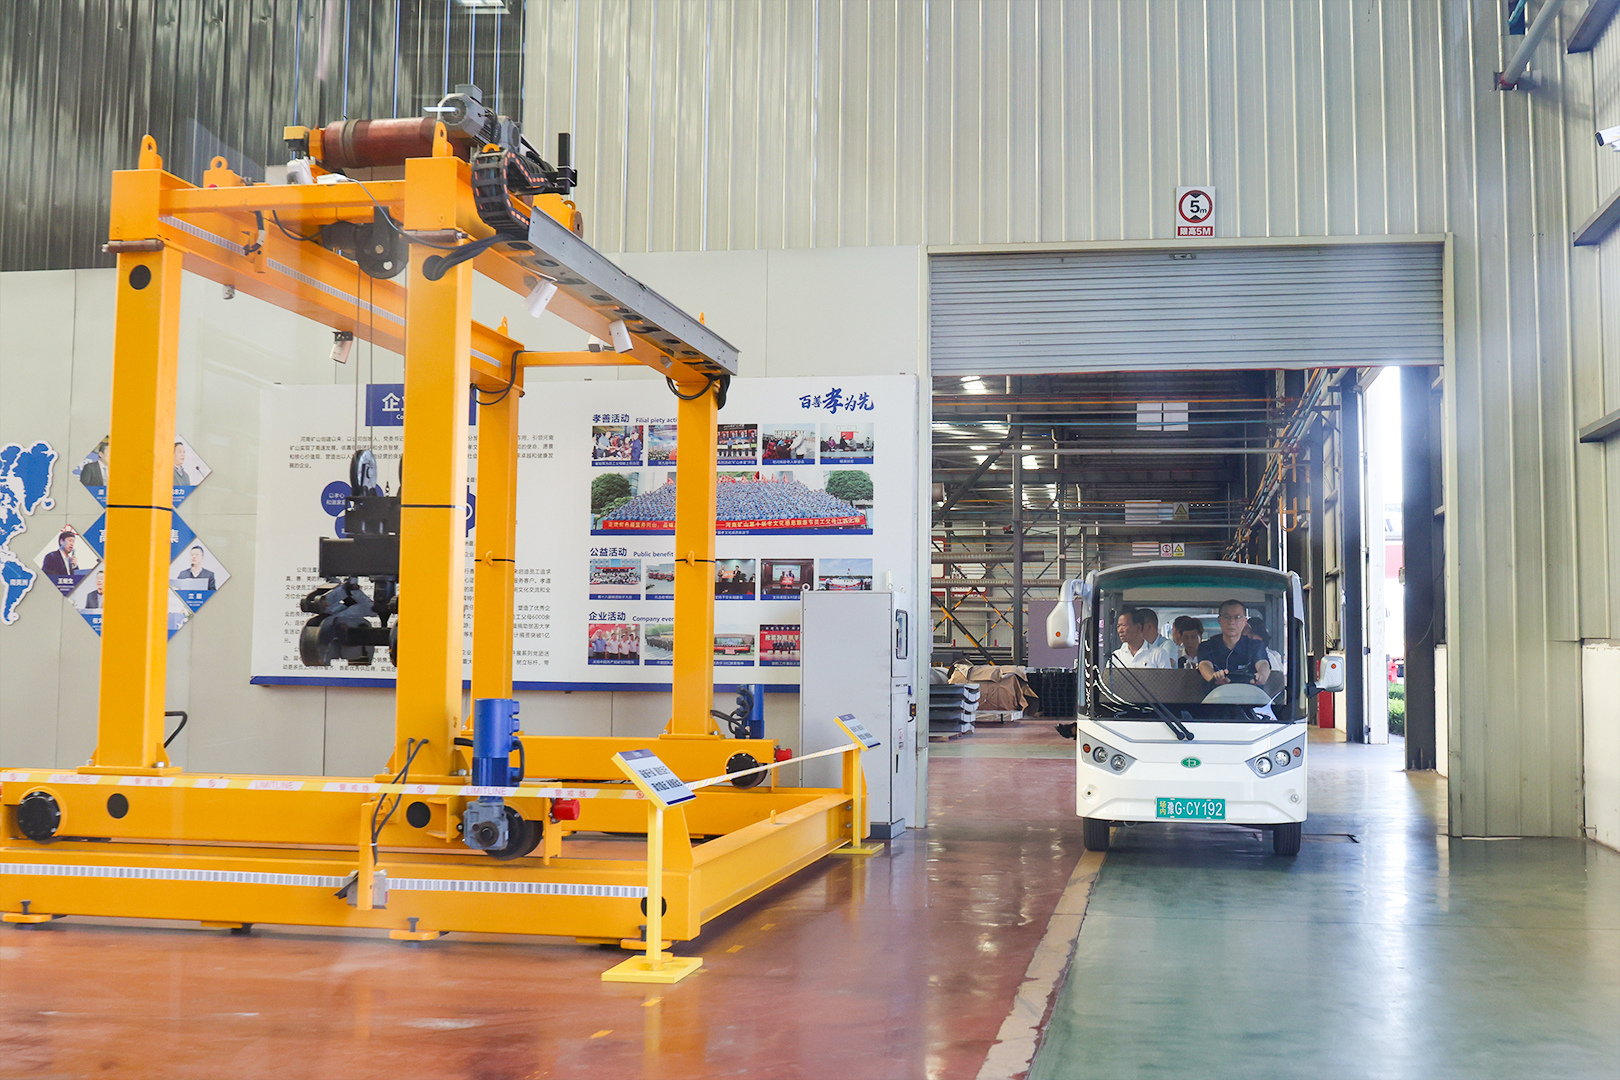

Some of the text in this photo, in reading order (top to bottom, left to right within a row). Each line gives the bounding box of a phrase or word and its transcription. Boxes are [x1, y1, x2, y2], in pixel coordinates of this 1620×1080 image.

[799, 387, 875, 415] 百善孝为先
[592, 413, 630, 424] 孝善活动
[589, 547, 628, 557] 公益活动
[588, 611, 626, 621] 企业活动
[632, 615, 660, 623] Company
[54, 774, 91, 784] LIMITLINE
[255, 781, 293, 790] LIMITLINE
[466, 786, 506, 796] LIMITLINE
[555, 789, 587, 798] 警戒线
